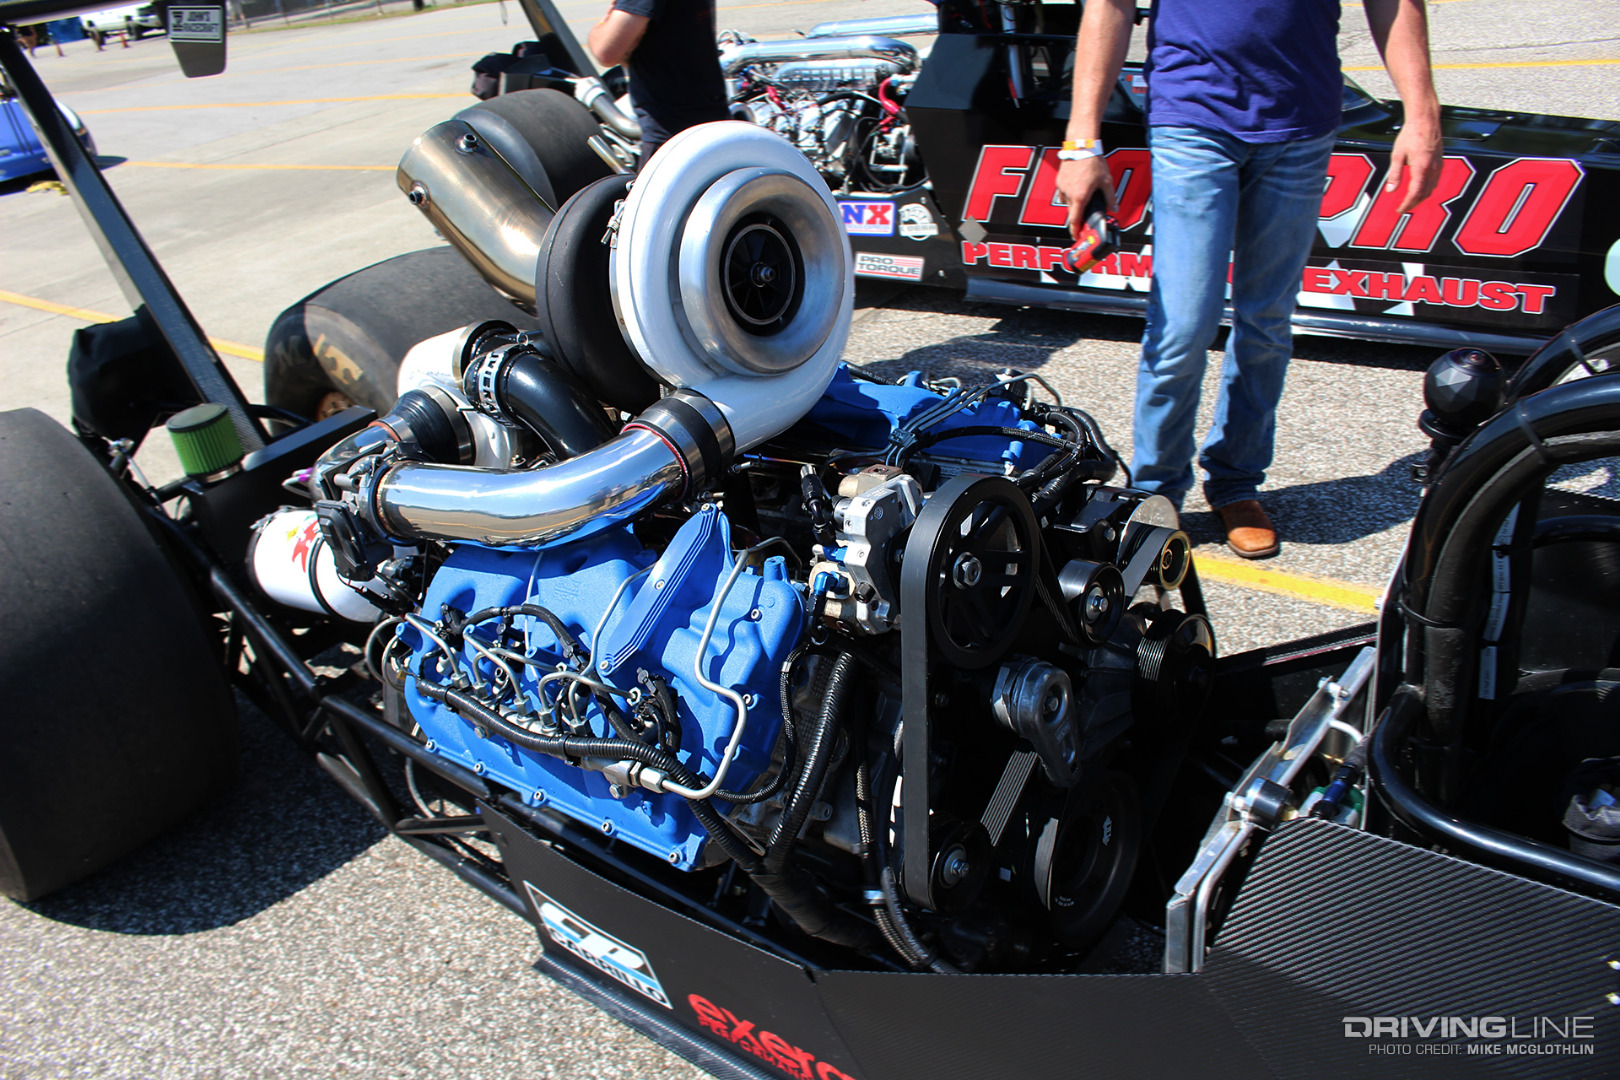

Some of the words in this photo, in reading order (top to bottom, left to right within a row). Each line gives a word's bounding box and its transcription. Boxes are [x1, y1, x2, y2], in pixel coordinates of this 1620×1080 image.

[840, 204, 892, 225] NX
[857, 263, 920, 275] TORQUE
[860, 255, 894, 265] PRO
[1301, 266, 1556, 315] EXHAUST
[550, 928, 668, 1004] CARRILLO
